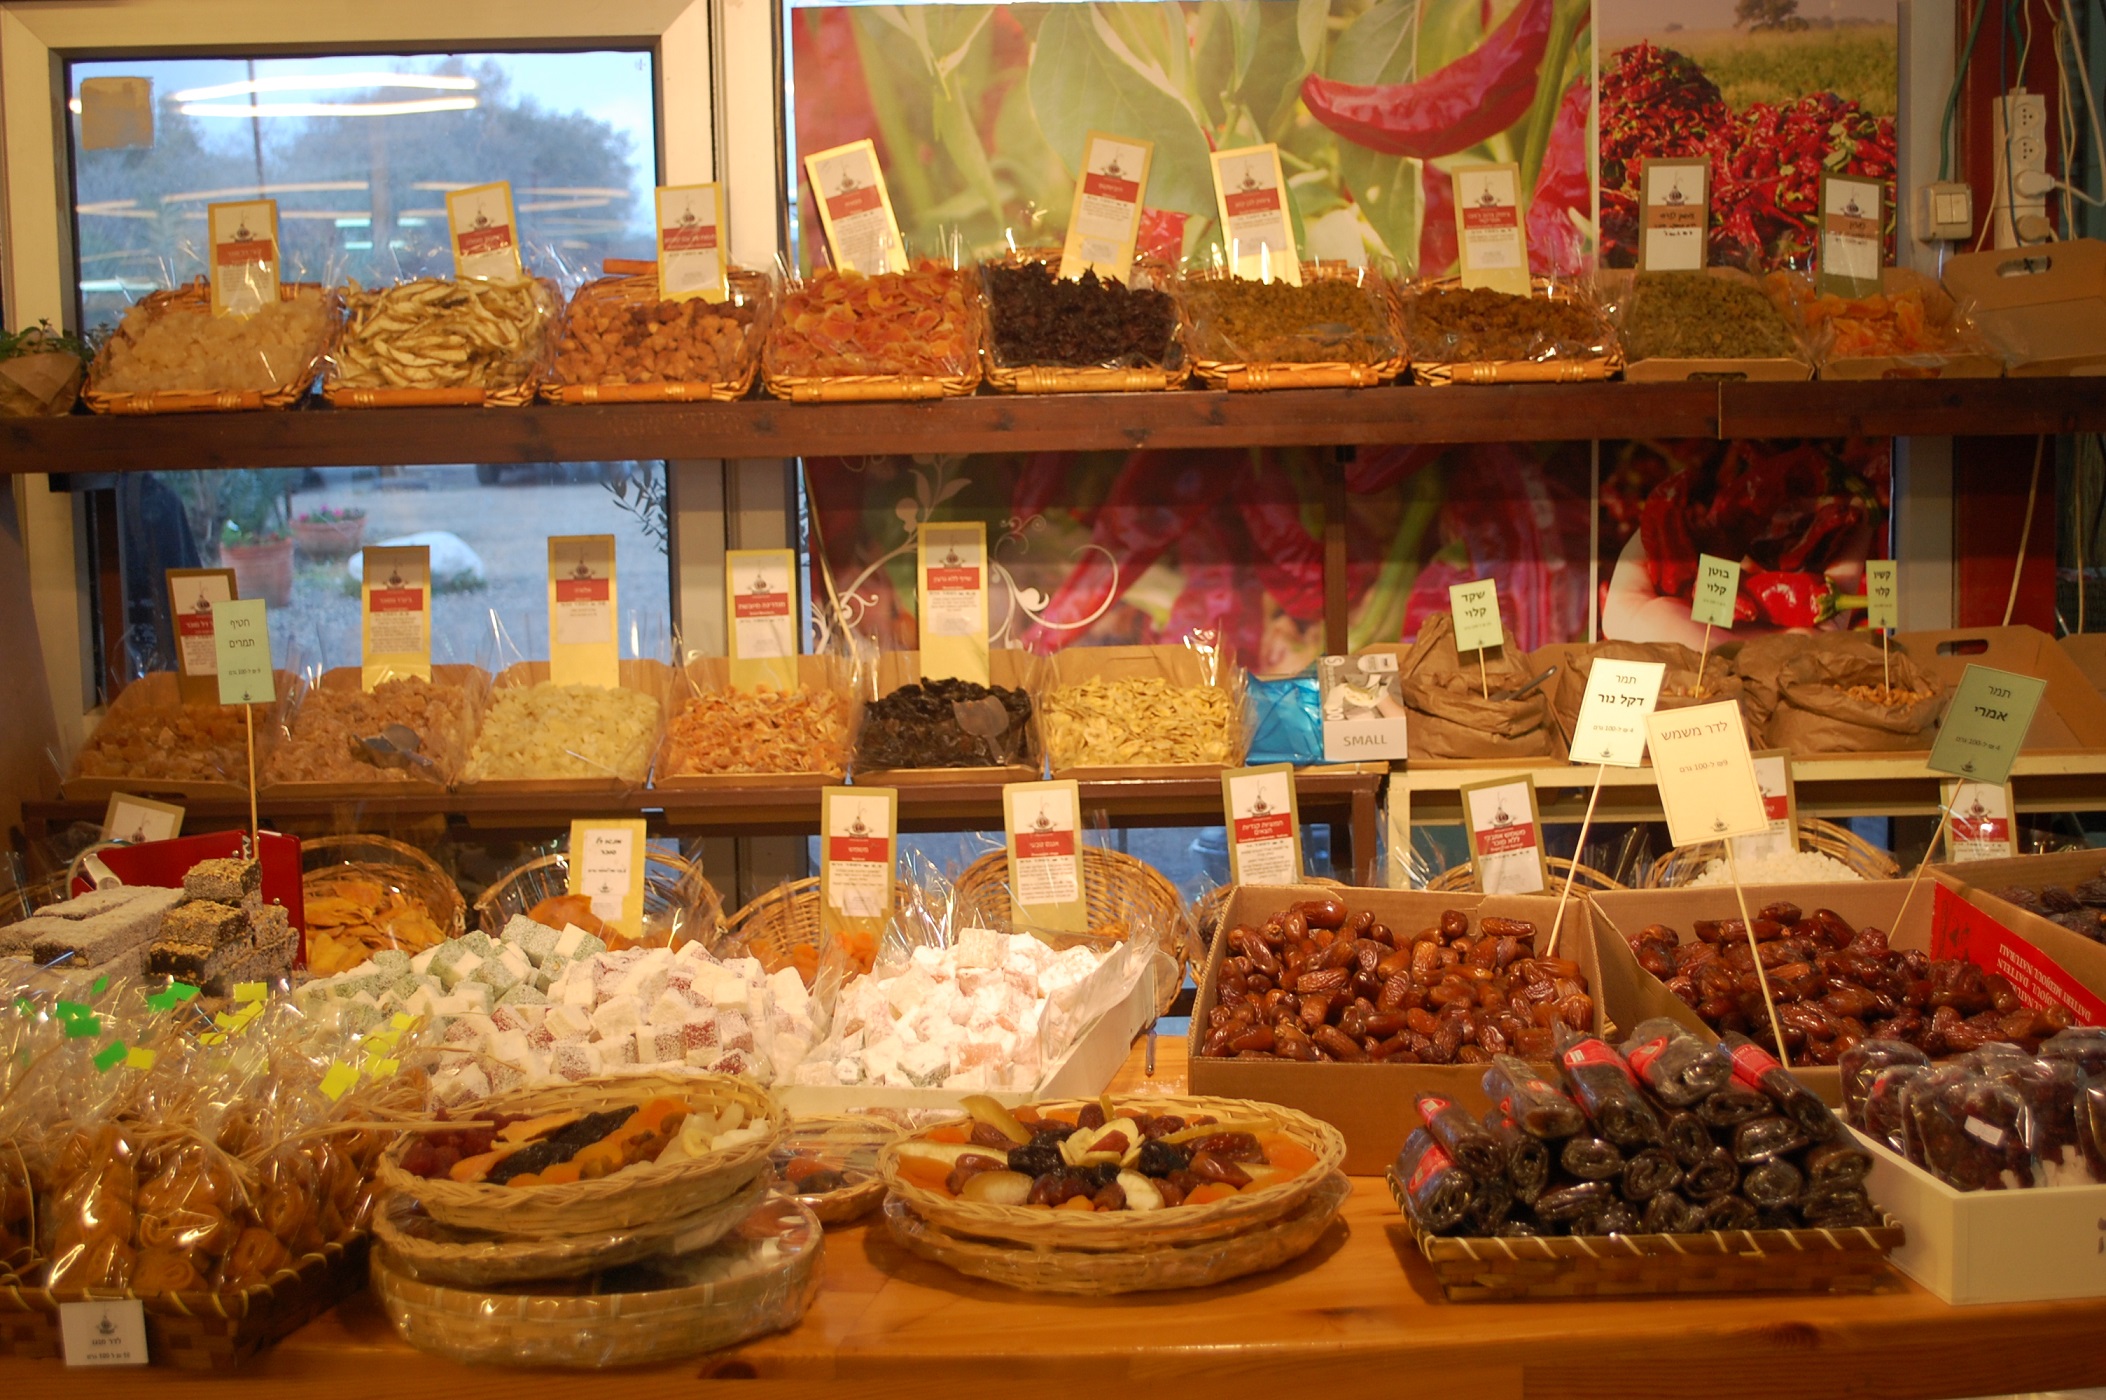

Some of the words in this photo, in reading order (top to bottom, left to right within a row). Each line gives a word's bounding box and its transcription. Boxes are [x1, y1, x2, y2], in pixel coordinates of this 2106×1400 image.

[1708, 566, 1730, 579] בוטן
[1873, 571, 1891, 582] קשיו
[1707, 583, 1727, 596] קלוי
[1875, 586, 1890, 598] קלוי
[1461, 590, 1486, 603] שקד
[1465, 607, 1487, 618] קלוי
[230, 618, 250, 630] חטיף
[229, 638, 255, 648] תמרים
[1616, 674, 1637, 685] תמר
[1598, 693, 1616, 704] נור
[1988, 685, 2011, 699] תמר
[1620, 694, 1645, 708] דקל
[1974, 705, 2009, 722] אמרי
[1661, 726, 1702, 741] משמש
[1704, 720, 1728, 734] לדר
[1343, 734, 1388, 747] SMALL
[1679, 765, 1693, 774] גרם
[1999, 943, 2033, 976] NATURALI
[2033, 967, 2063, 997] MEDJOUL
